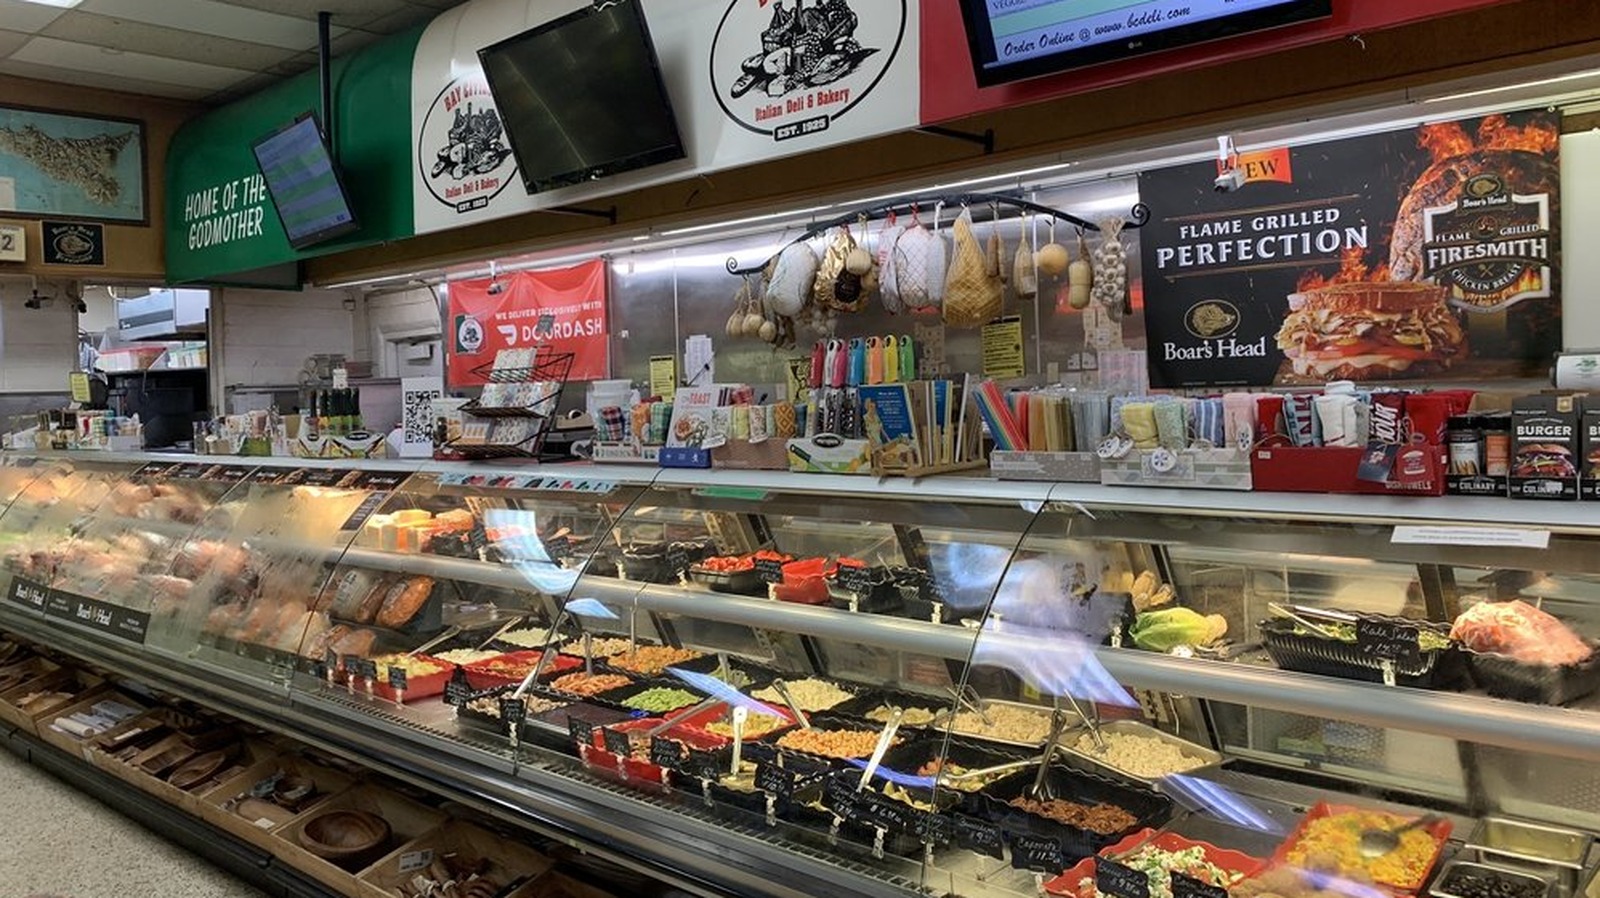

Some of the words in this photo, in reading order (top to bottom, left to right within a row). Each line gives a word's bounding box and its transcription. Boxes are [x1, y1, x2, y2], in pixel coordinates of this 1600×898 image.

[1004, 39, 1036, 57] Order
[1039, 31, 1075, 49] Online
[1079, 28, 1091, 42] @
[755, 105, 783, 121] Italian
[786, 97, 804, 114] Deli
[816, 88, 850, 107] Bakery
[776, 125, 800, 139] EST.
[802, 117, 826, 133] 1925
[1244, 158, 1280, 179] EW
[185, 187, 219, 222] HOME
[222, 181, 239, 211] OF
[243, 173, 266, 206] THE
[188, 206, 263, 250] GODMOTHER
[1180, 219, 1242, 240] FLAME
[1251, 208, 1340, 232] GRILLED
[1435, 231, 1471, 243] FLAME
[1500, 223, 1540, 236] GRILLED
[1157, 225, 1369, 268] PERFECTION
[1427, 238, 1548, 270] FIRESMITH
[1451, 268, 1490, 290] CHICKEN
[1493, 263, 1521, 288] BREAST
[1163, 340, 1213, 360] Boar's
[1217, 336, 1266, 358] Head
[1516, 425, 1572, 436] BURGER
